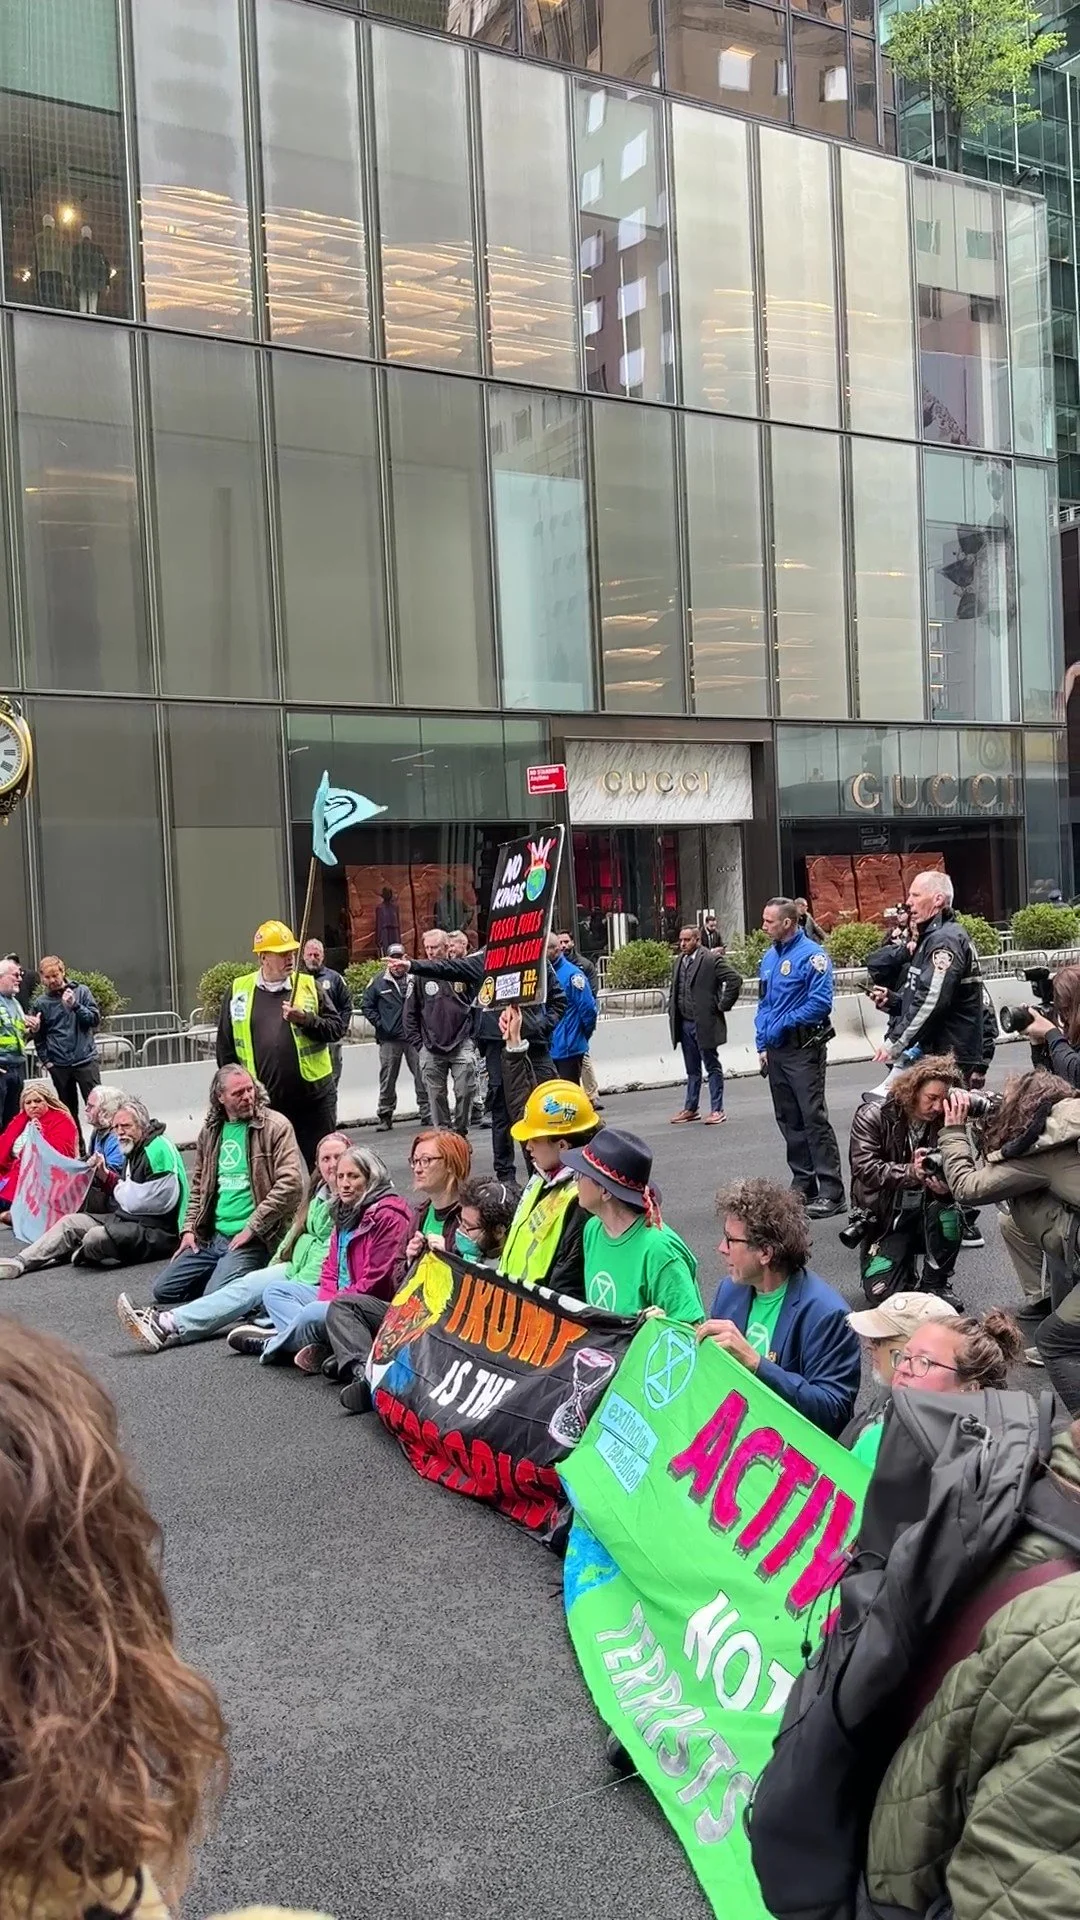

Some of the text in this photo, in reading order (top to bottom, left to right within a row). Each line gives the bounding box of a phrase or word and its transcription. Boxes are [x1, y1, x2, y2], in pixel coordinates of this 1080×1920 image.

[603, 770, 710, 794] GUCCI
[852, 771, 1016, 809] GUCCI
[502, 854, 523, 885] NO
[493, 881, 526, 910] KINGS
[490, 909, 543, 942] FOSSIL FUELS
[485, 939, 543, 970] FUND FASCISM
[444, 1273, 589, 1368] TRUMP
[429, 1360, 516, 1420] IS THE
[608, 1403, 650, 1453] extinction
[607, 1439, 641, 1489] rebellion
[667, 1389, 857, 1625] ACTIV
[683, 1589, 798, 1714] NOT
